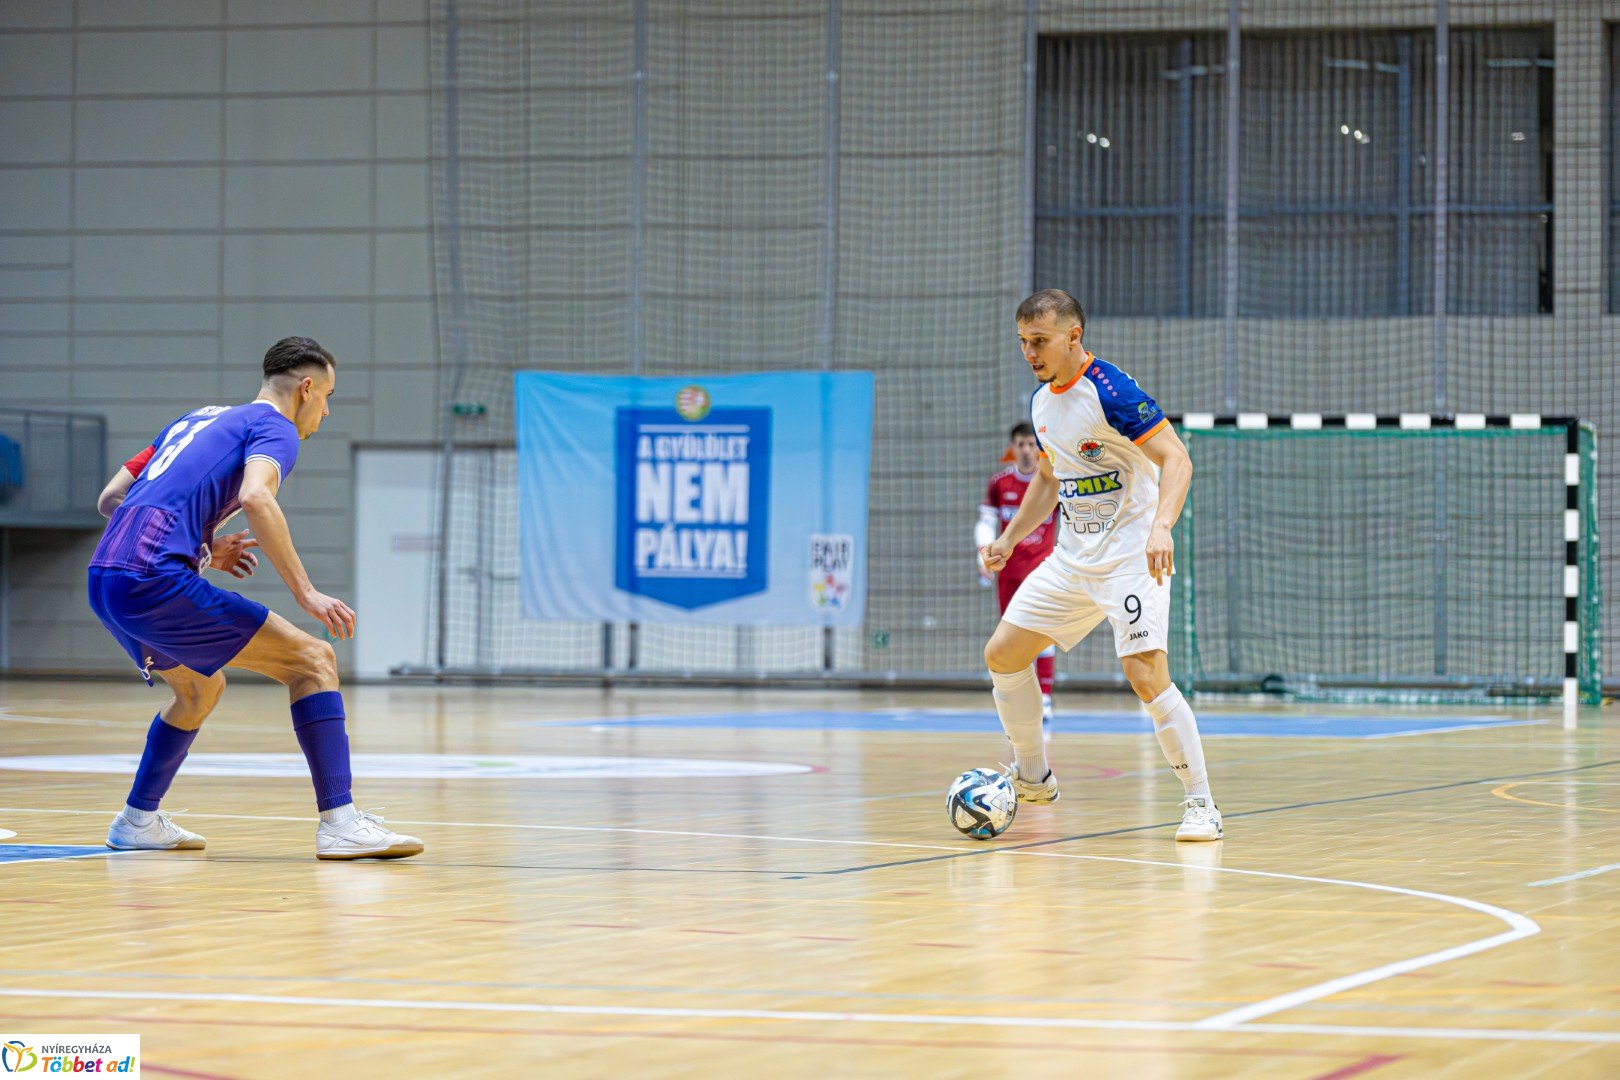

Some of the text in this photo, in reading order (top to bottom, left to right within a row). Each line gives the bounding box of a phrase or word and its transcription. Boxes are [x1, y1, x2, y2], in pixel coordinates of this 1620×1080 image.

[637, 434, 653, 459] A
[636, 461, 750, 524] NEM
[634, 522, 748, 570] PÁLYA!
[1124, 594, 1142, 625] 9
[1130, 630, 1149, 640] JAKO
